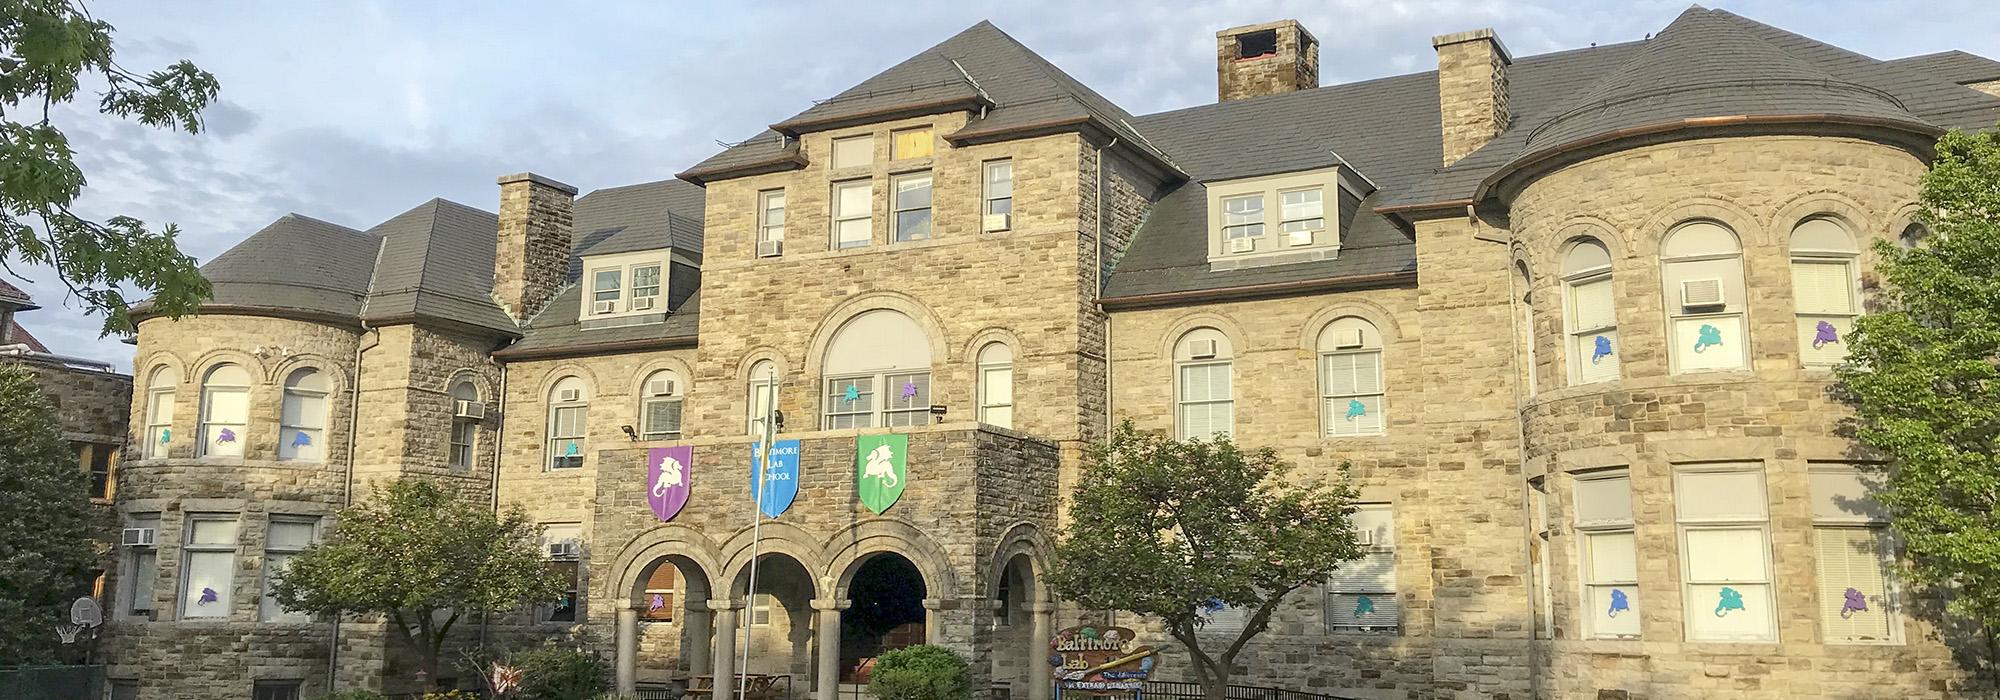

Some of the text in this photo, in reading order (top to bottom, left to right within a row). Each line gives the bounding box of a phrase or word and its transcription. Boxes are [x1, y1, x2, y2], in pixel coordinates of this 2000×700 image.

[754, 447, 797, 457] BTIMORE
[767, 460, 783, 468] LAB
[1056, 634, 1133, 654] Baltimore
[1061, 653, 1088, 670] Lab
